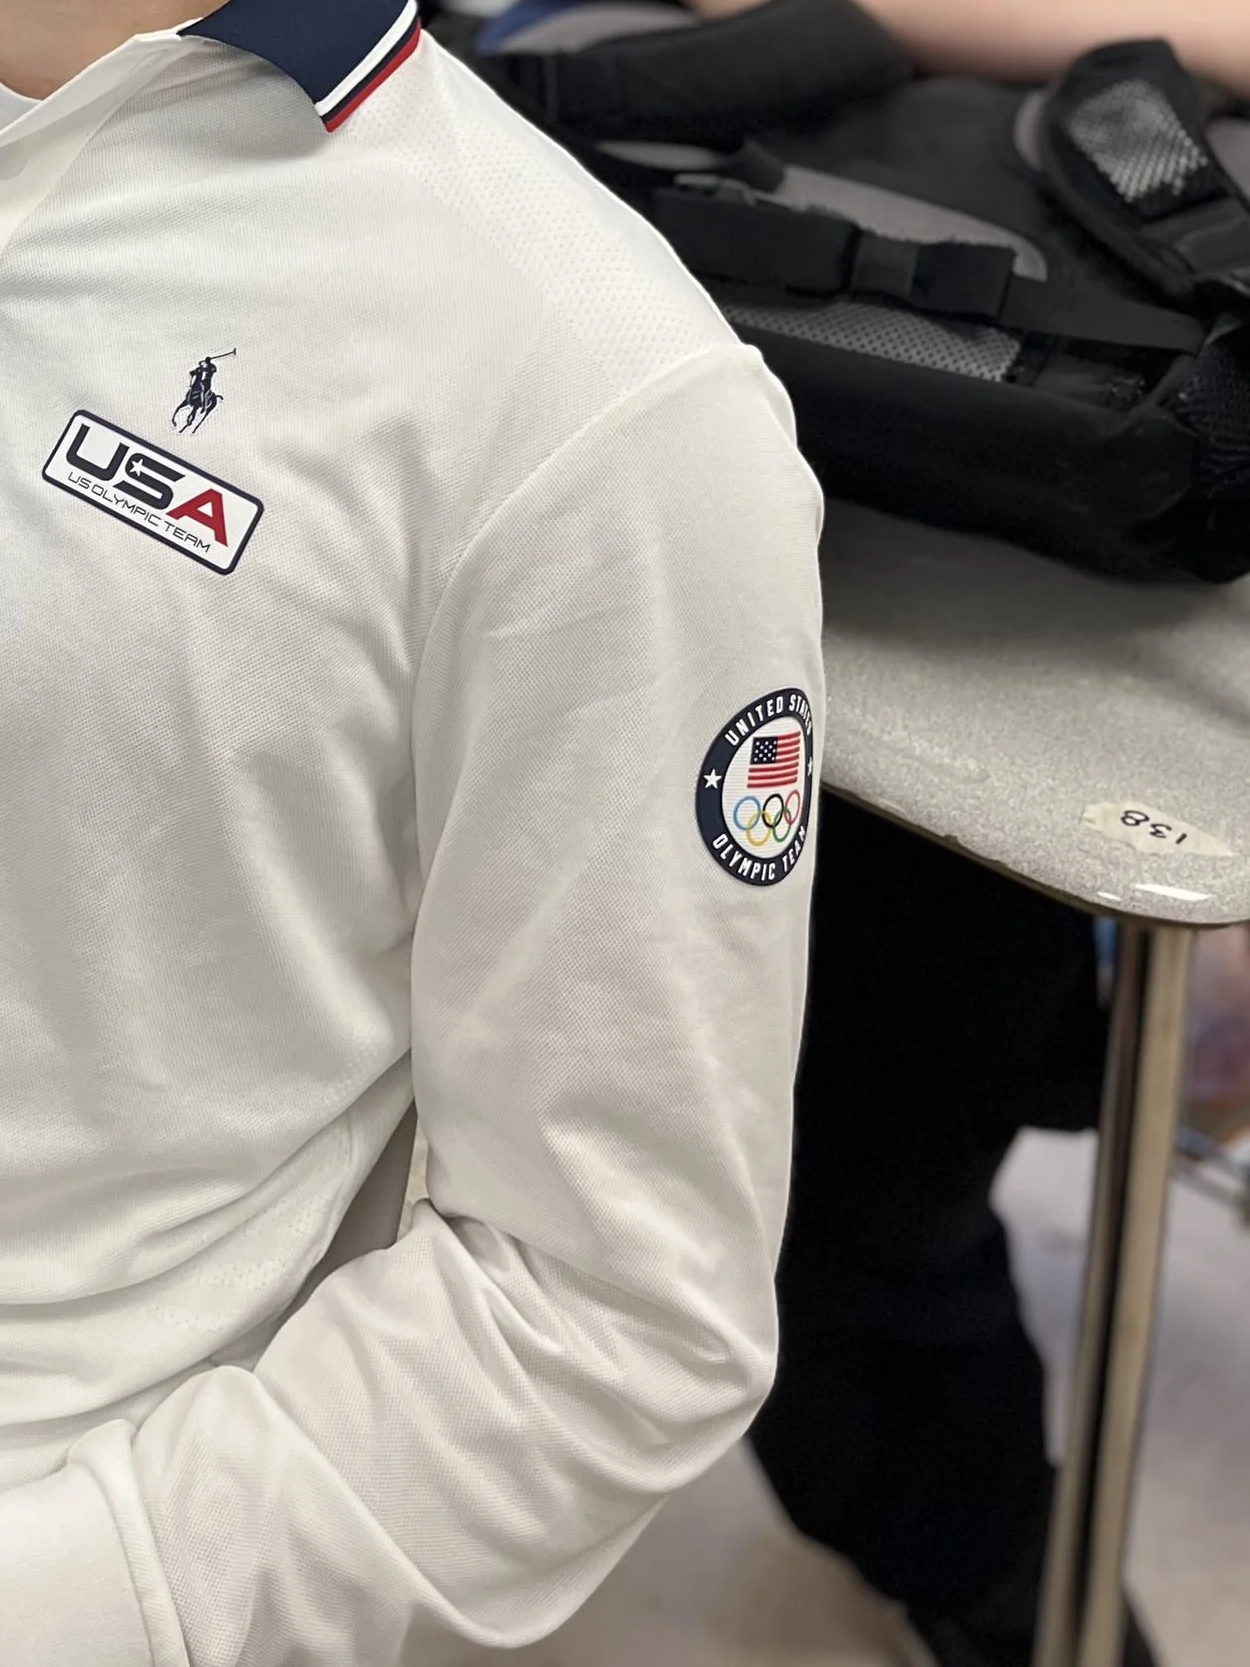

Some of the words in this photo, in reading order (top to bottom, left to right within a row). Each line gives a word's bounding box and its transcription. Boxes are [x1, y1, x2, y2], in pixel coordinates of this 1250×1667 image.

[66, 423, 229, 548] USA
[67, 471, 92, 490] US
[91, 484, 162, 528] OLYMPIC
[164, 520, 211, 554] TEAM
[724, 696, 784, 747] UNITED
[788, 694, 812, 736] STATES
[712, 833, 777, 881] OLYMPIC
[782, 825, 807, 873] TEAM
